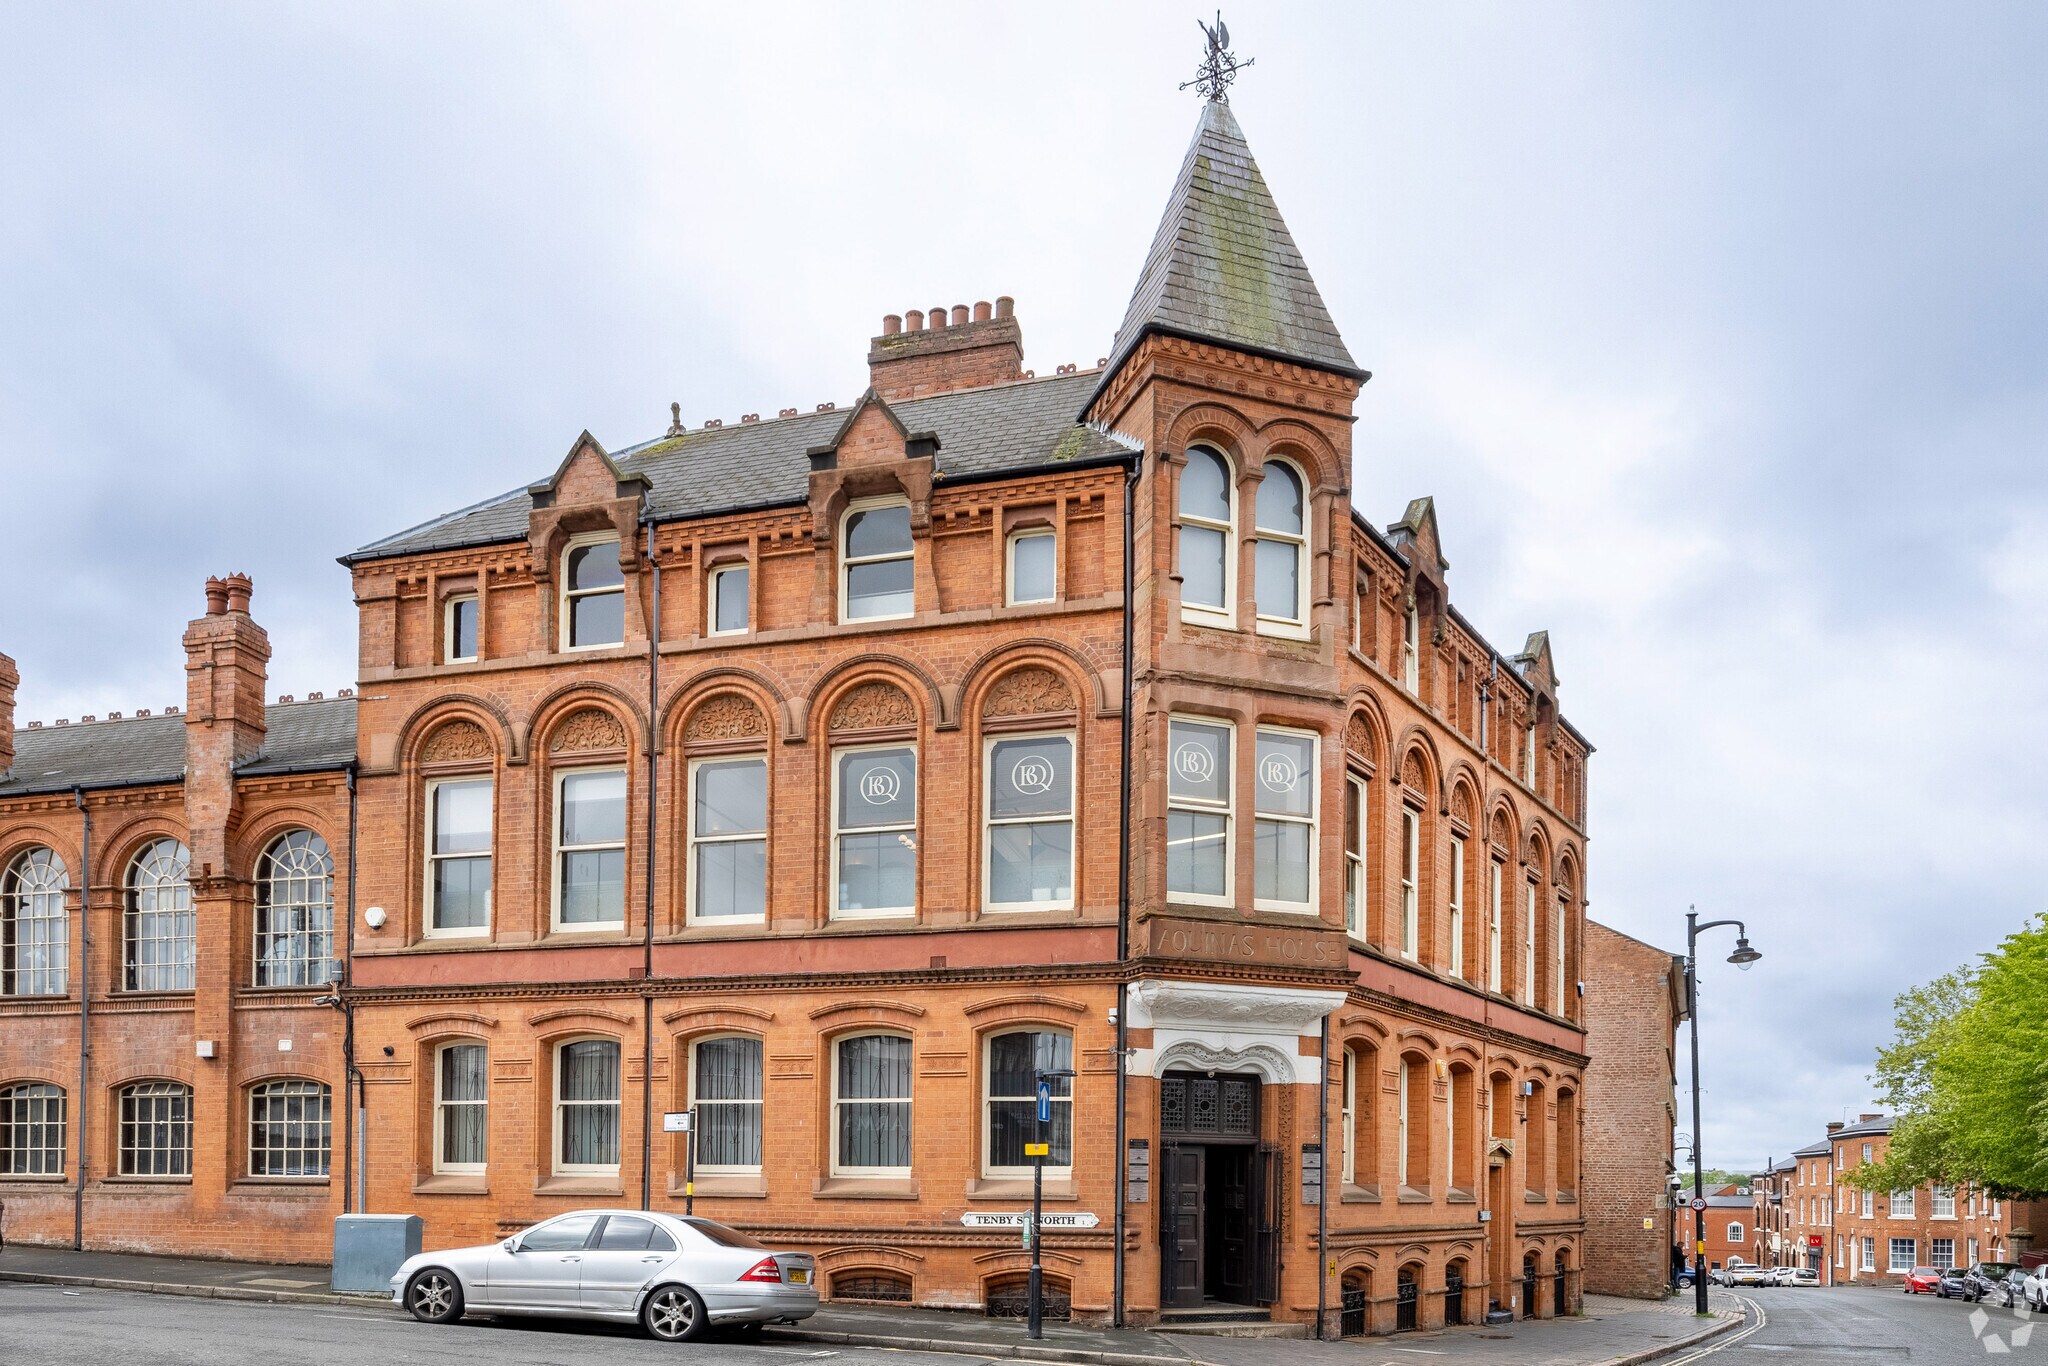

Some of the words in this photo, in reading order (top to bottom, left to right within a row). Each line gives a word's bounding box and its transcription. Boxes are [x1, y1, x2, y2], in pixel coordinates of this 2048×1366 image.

[1157, 928, 1255, 957] AQUINAS
[1265, 936, 1343, 963] HOUSE
[975, 1216, 1013, 1225] TENBY
